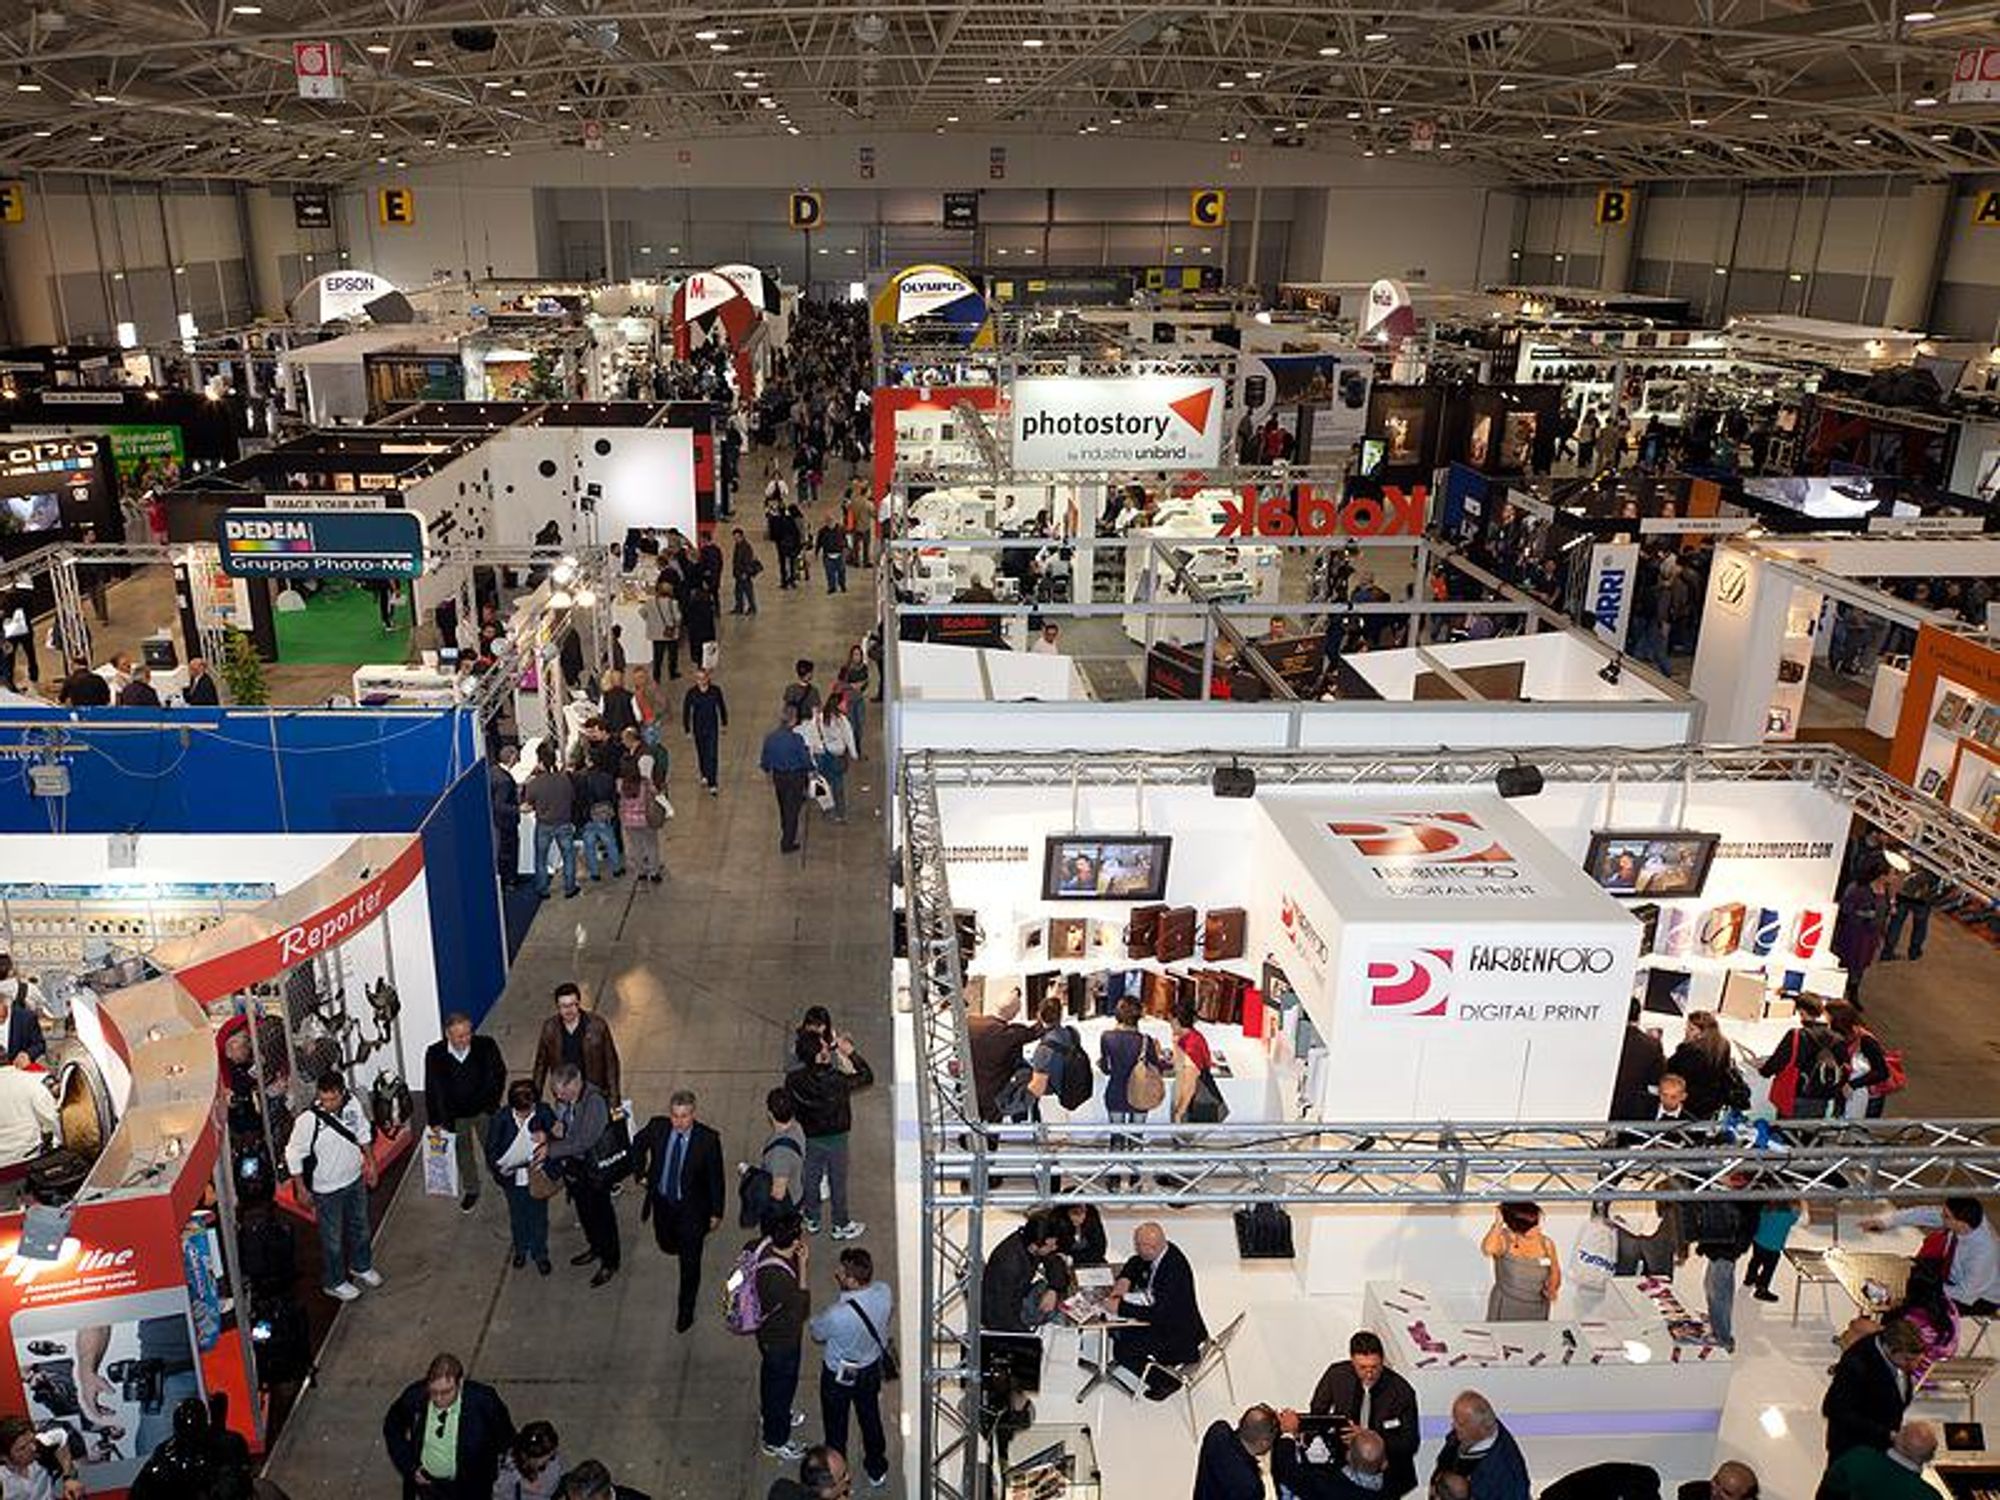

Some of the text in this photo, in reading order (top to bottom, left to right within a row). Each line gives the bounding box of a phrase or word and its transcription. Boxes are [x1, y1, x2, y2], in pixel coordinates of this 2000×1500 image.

[386, 190, 405, 221] E
[793, 195, 819, 224] D
[1196, 192, 1218, 223] C
[1602, 192, 1624, 222] B
[326, 277, 374, 291] EPSON
[902, 281, 966, 293] OLYMPUS
[1022, 410, 1170, 441] photostory
[225, 520, 308, 540] DEDEM
[231, 556, 414, 573] Gruppo Photo-Me
[1595, 569, 1626, 634] ARRI
[277, 882, 386, 963] Reporter
[1469, 945, 1613, 974] FARBENFOTO
[1460, 1004, 1600, 1021] DIGITAL PRINT
